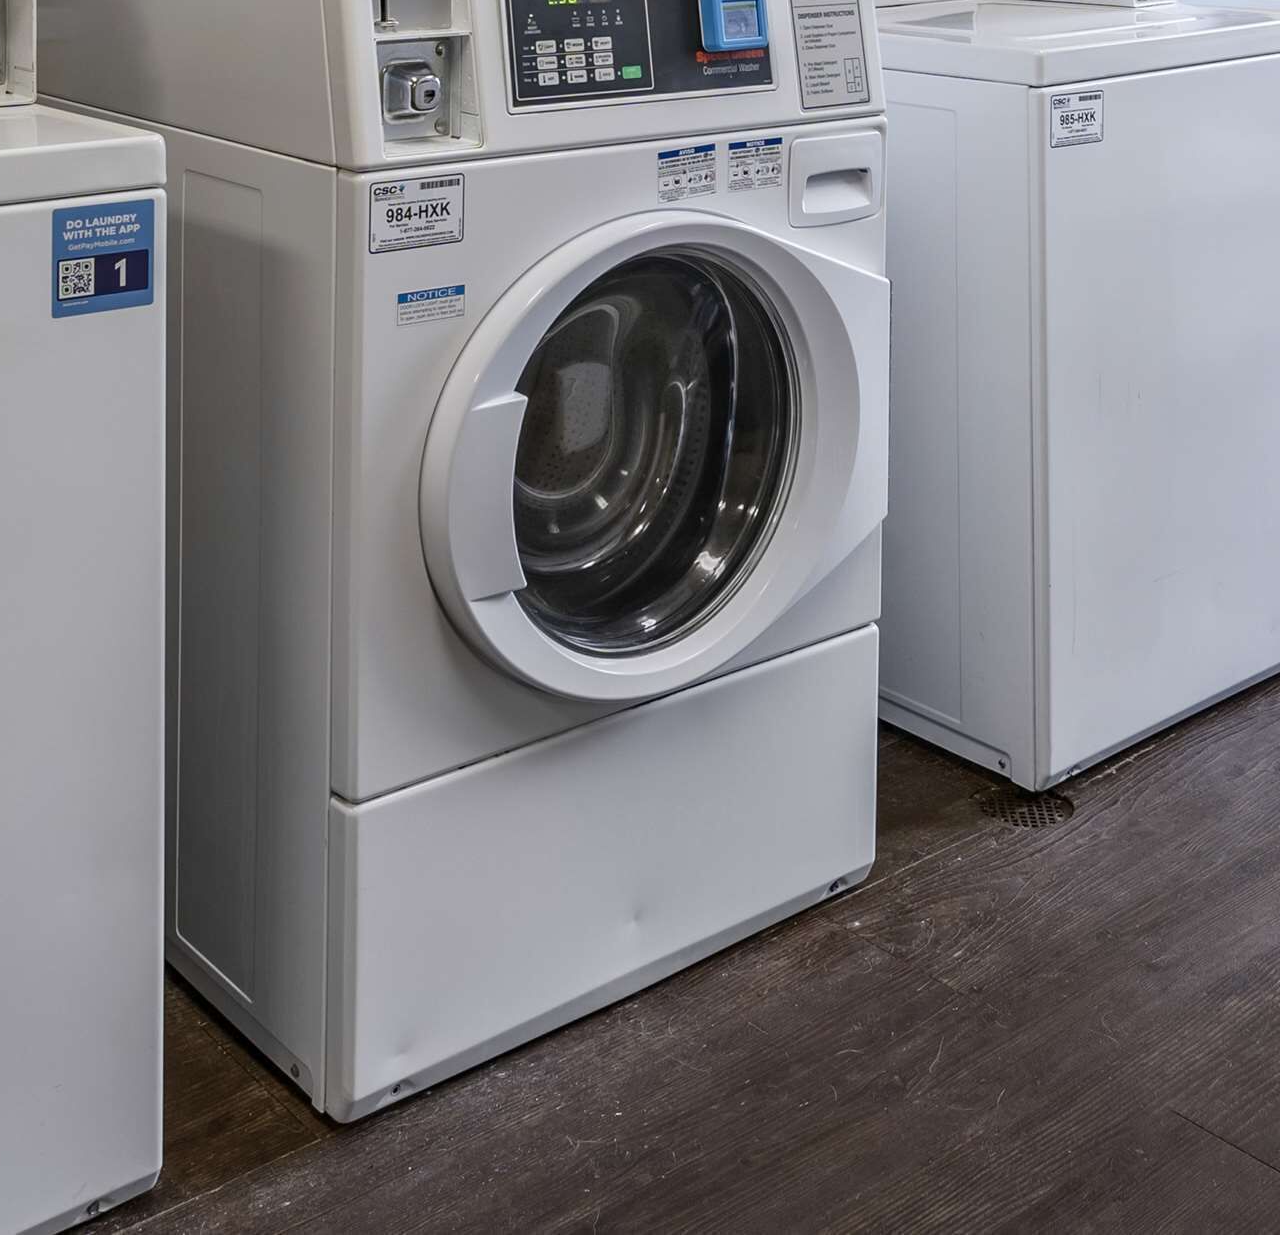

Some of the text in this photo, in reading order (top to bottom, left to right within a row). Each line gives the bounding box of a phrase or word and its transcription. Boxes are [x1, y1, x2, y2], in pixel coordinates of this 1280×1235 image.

[1060, 111, 1096, 126] 985-HXK
[373, 186, 397, 196] CSC
[386, 201, 451, 223] 984-HXK
[66, 213, 137, 230] DO LAUNDRY
[62, 223, 141, 241] WITH THE APP
[114, 257, 127, 287] 1
[407, 287, 456, 302] NOTICE
